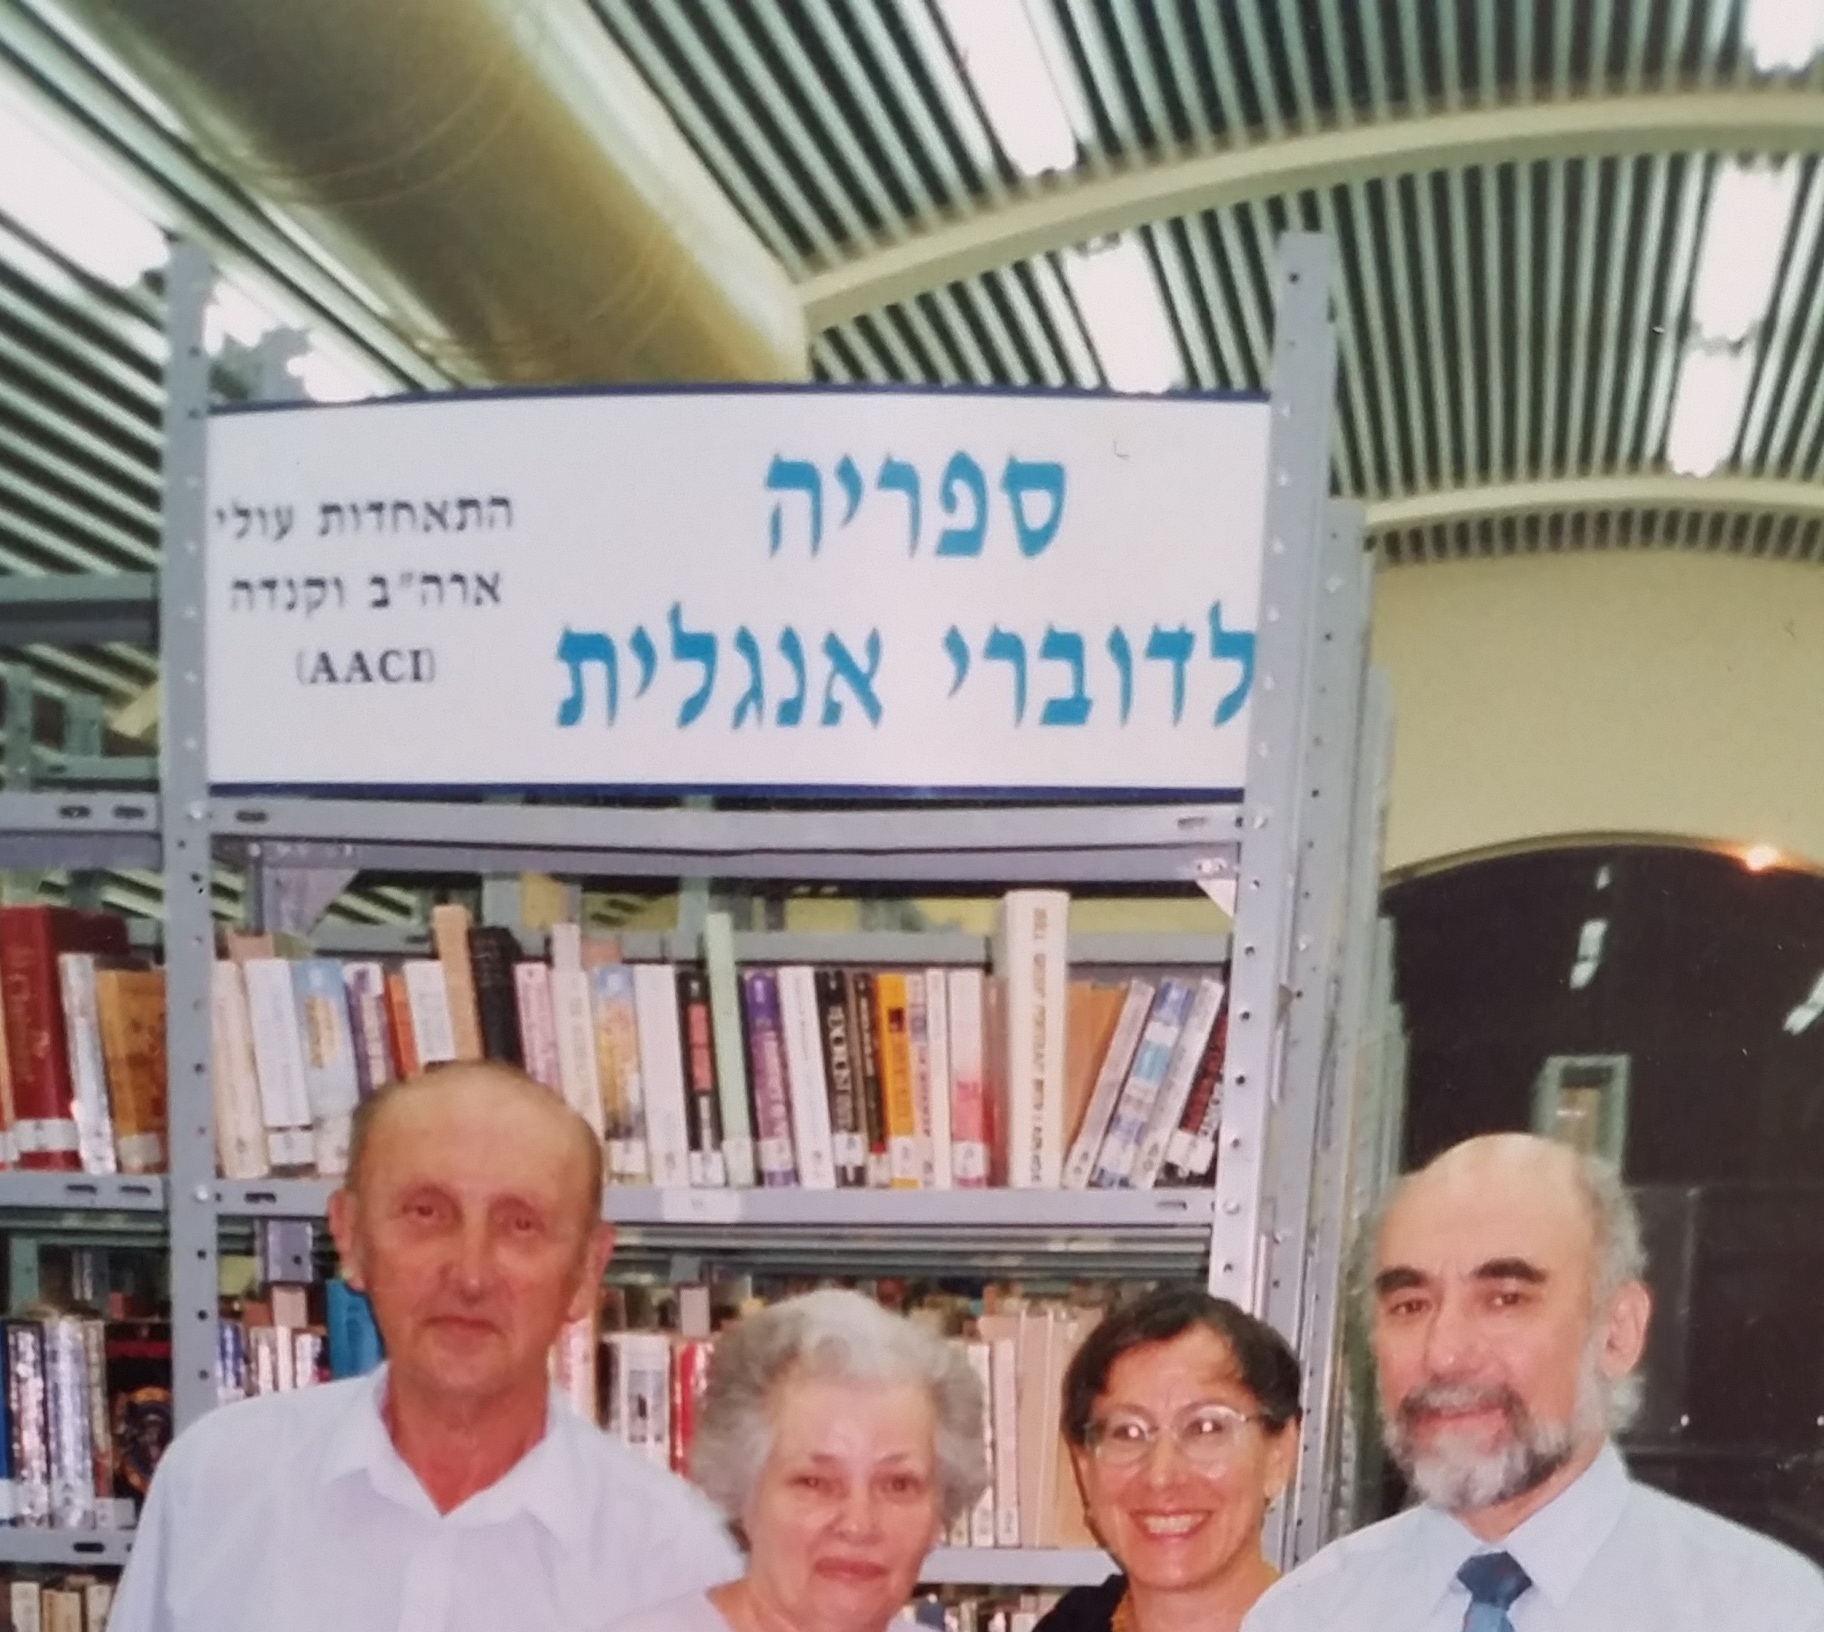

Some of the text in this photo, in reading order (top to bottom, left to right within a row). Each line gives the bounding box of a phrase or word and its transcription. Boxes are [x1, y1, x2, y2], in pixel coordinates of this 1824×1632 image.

[215, 495, 512, 542] התאחדות עולי
[765, 451, 1067, 558] ספריה
[231, 575, 345, 617] וקנדה
[296, 648, 436, 685] (AACI)
[556, 600, 1257, 729] לדוברי אנגלית
